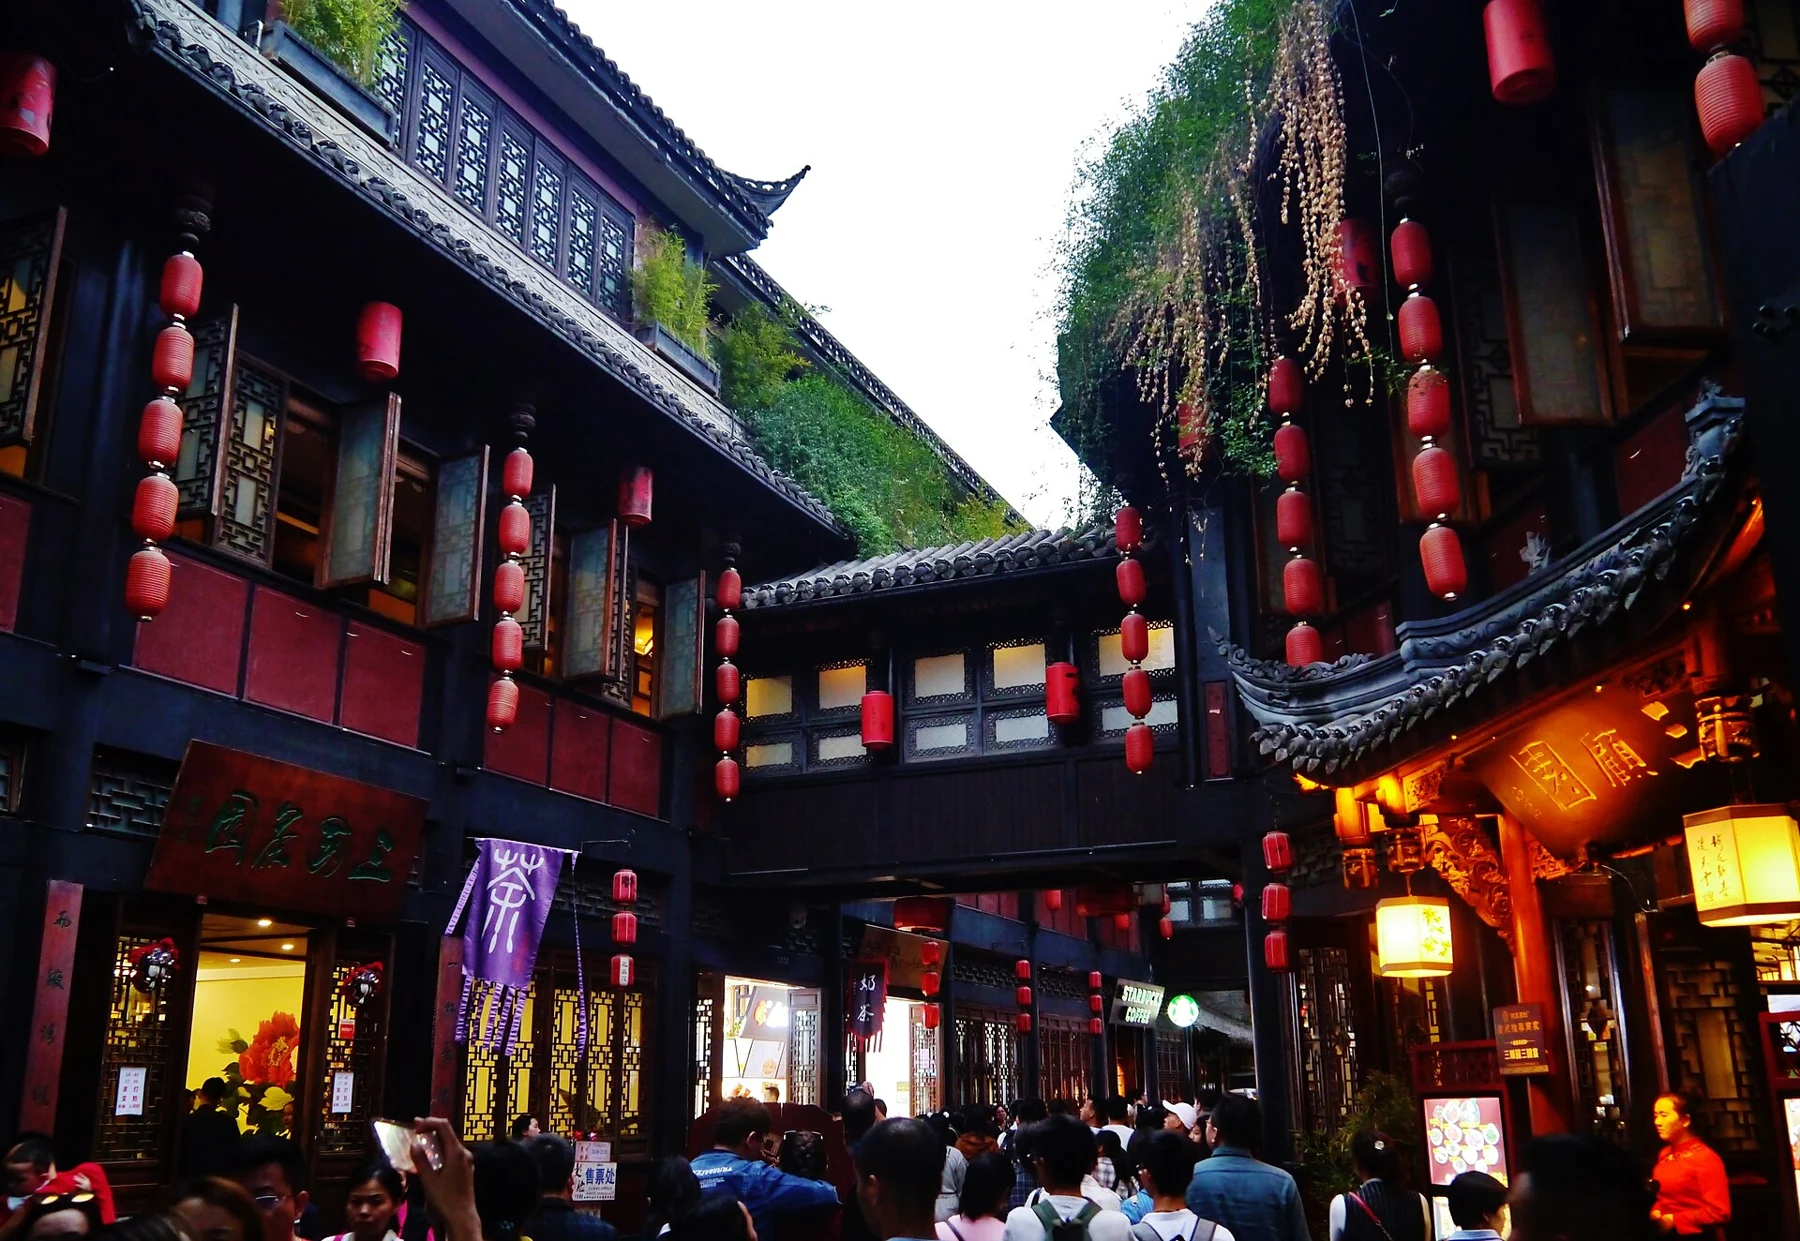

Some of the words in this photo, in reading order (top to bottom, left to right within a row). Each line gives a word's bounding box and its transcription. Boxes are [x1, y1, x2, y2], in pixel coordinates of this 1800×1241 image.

[857, 973, 876, 1022] 奶茶
[1122, 985, 1163, 1006] STARBUCKS
[1125, 1006, 1152, 1024] COFFEE
[585, 1167, 615, 1185] 售票处
